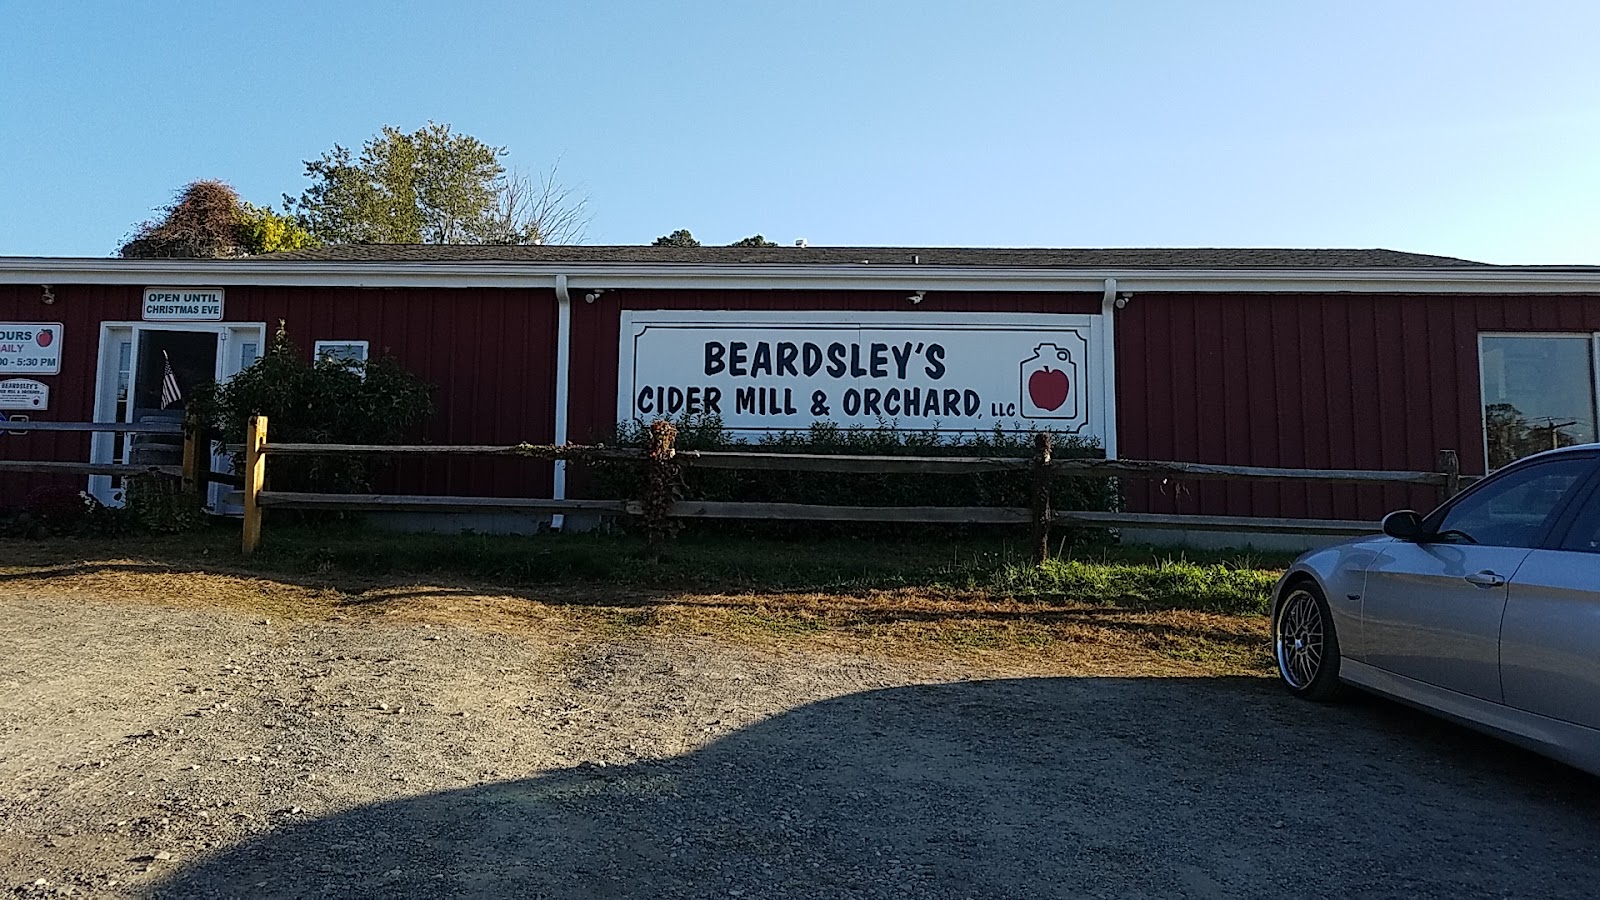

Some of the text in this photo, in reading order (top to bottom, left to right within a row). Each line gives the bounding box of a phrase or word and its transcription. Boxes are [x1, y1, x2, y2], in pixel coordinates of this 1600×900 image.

[148, 293, 219, 302] OPEN UNTIL
[146, 305, 219, 314] CHRISTMAS EVE
[17, 358, 38, 366] 5:30
[40, 358, 56, 366] PM
[704, 341, 945, 380] BEARDSLEY'S
[637, 385, 1016, 419] CIDER MILL & ORCHARD, LLC
